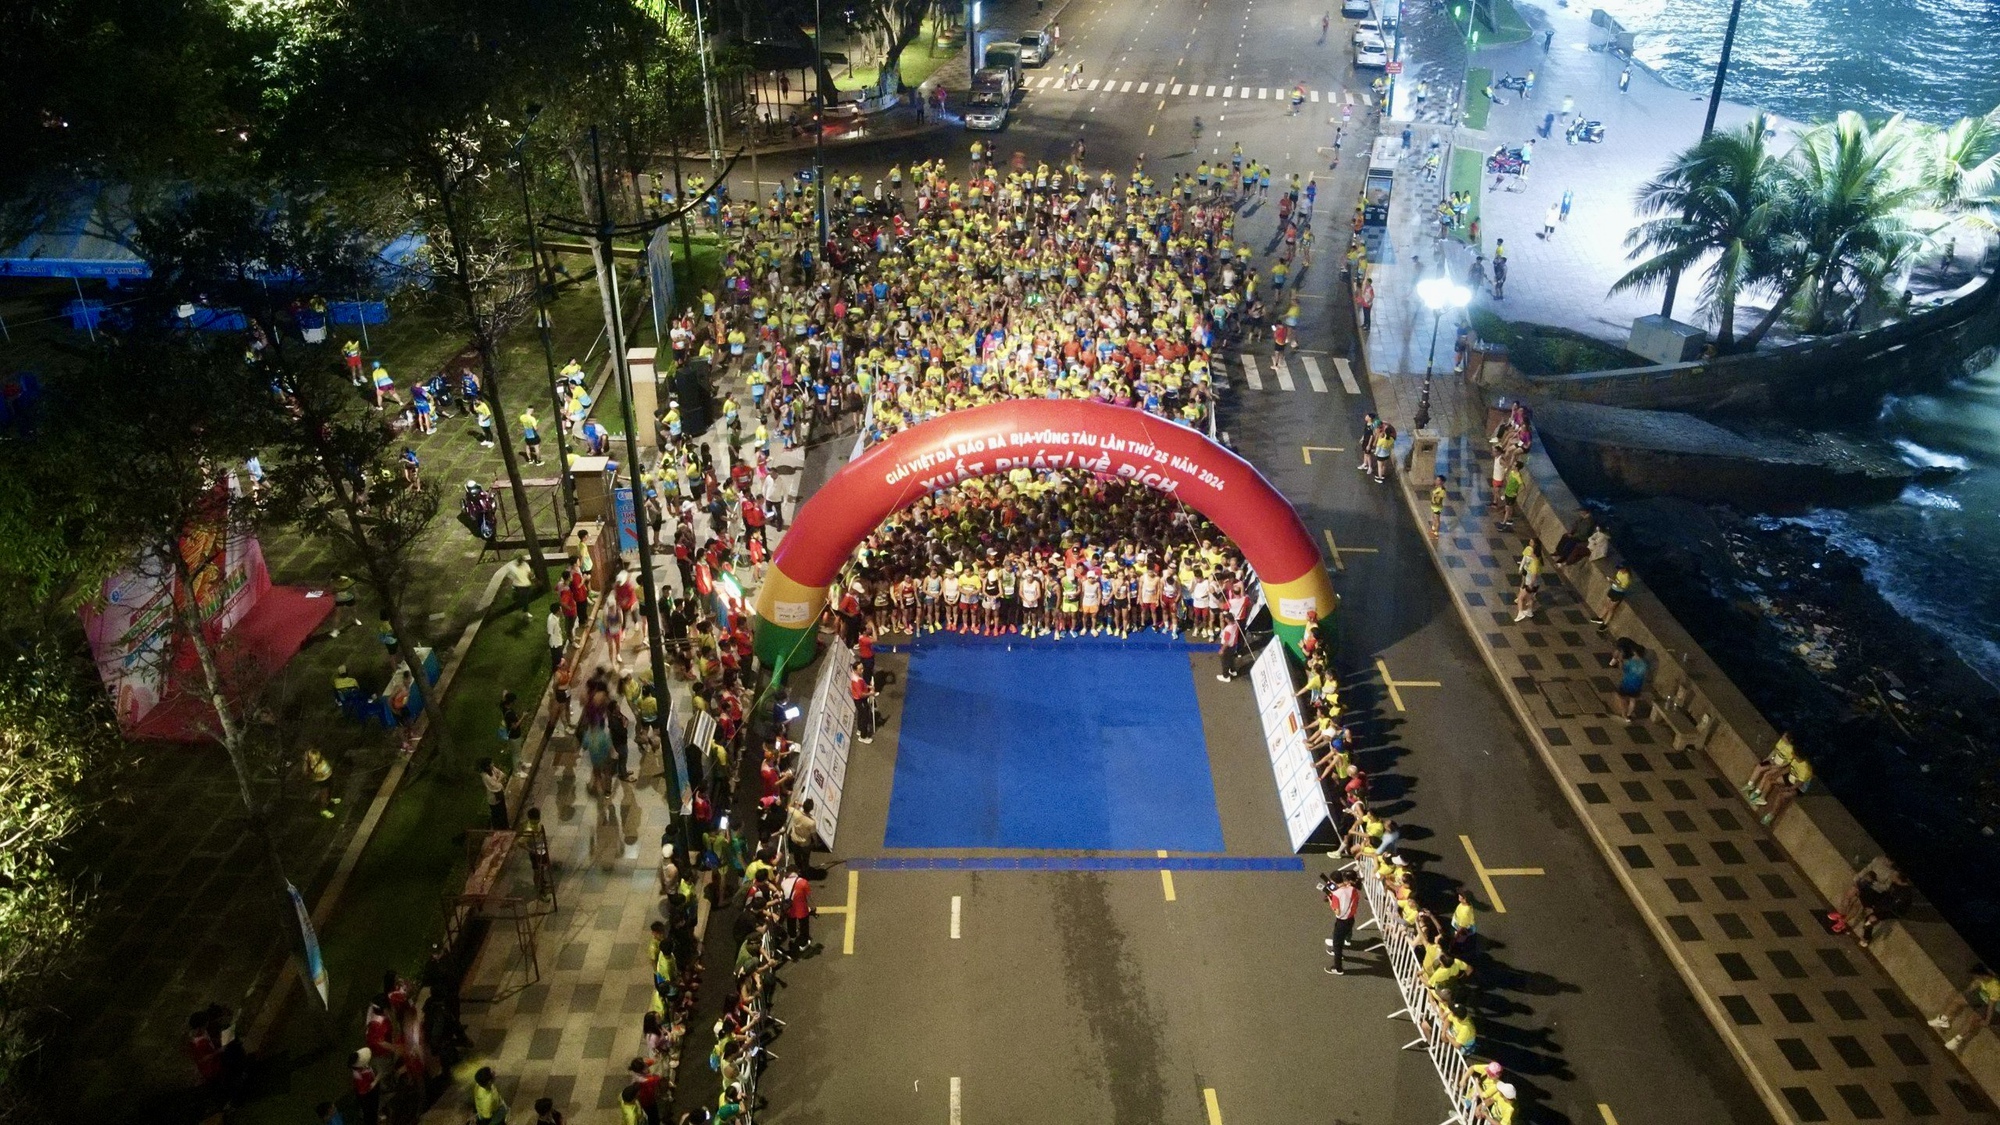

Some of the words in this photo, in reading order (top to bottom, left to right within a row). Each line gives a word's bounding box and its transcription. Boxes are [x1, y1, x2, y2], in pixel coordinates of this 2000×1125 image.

[886, 463, 910, 485] GIẢI
[909, 453, 936, 471] VIỆT
[988, 433, 1007, 450] BÀ
[1010, 429, 1070, 447] RỊA-VŨNG
[1071, 430, 1097, 446] TÀU
[1100, 433, 1126, 452] LẦN
[1128, 442, 1155, 458] THỨ
[1154, 449, 1169, 464] 25
[1170, 456, 1198, 476] NĂM
[1198, 469, 1226, 491] 2024
[1078, 451, 1111, 473] VỀ
[1116, 463, 1179, 493] ĐÍCH
